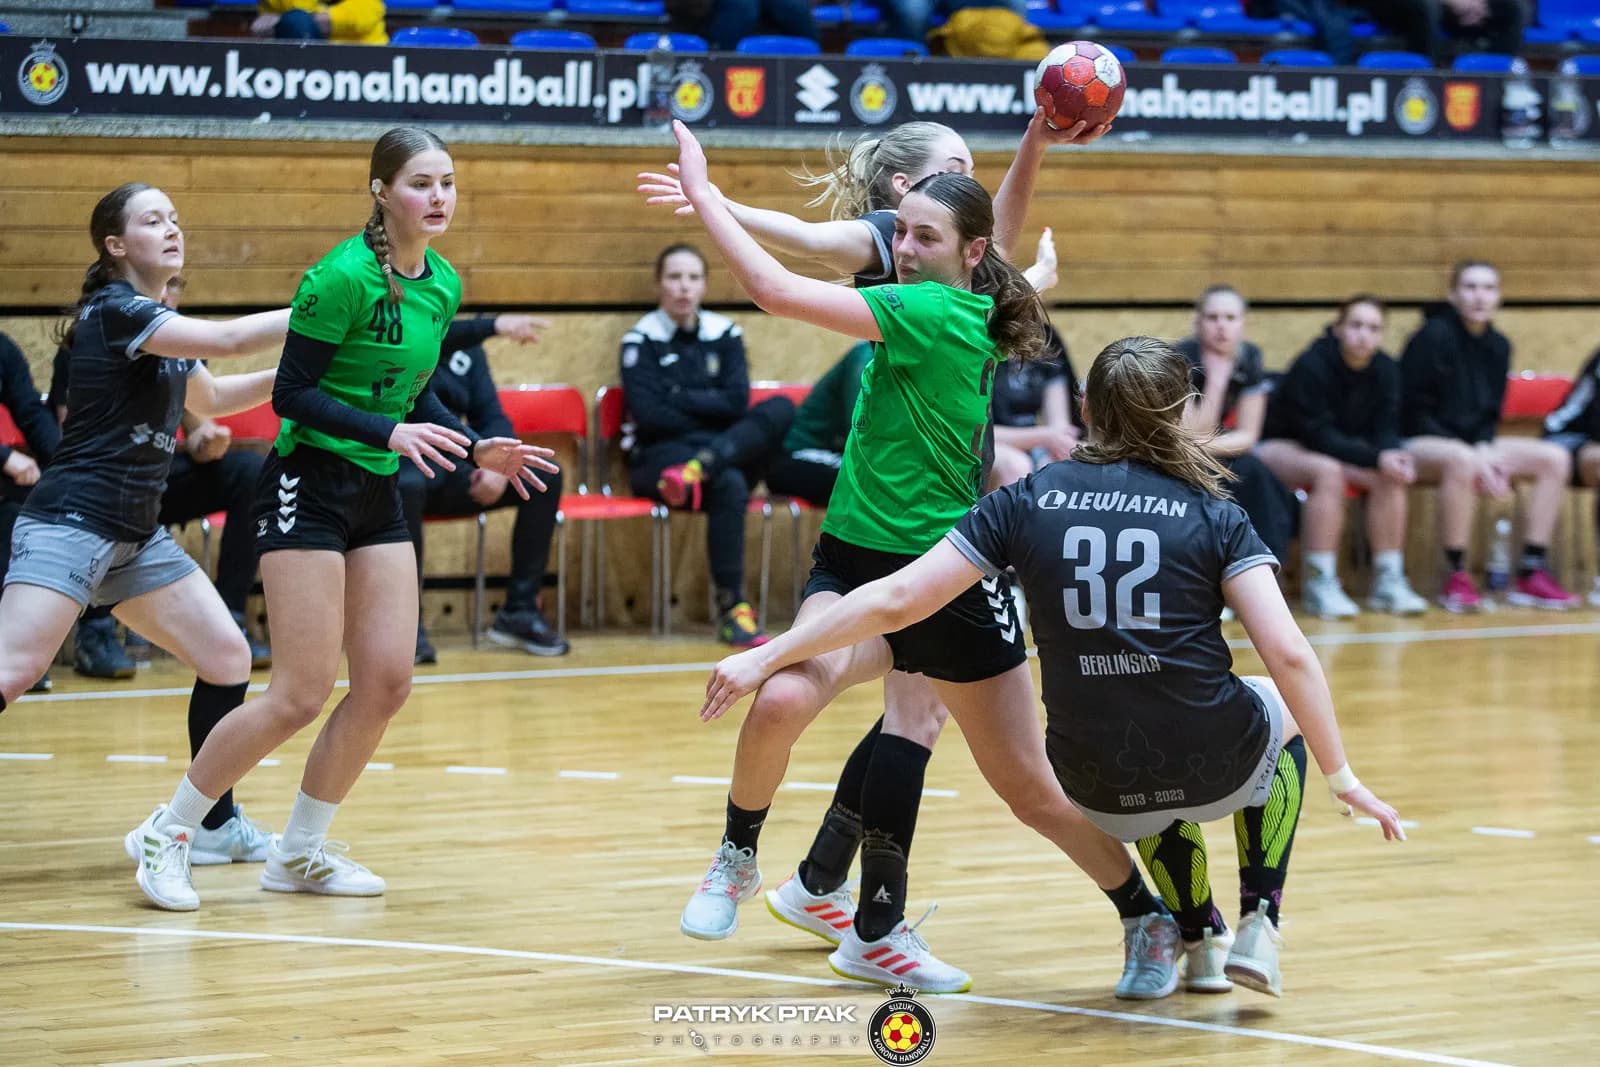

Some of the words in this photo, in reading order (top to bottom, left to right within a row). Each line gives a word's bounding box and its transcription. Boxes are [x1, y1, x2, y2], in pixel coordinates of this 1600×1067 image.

[85, 49, 652, 123] www.koronahandball.pl
[367, 298, 403, 346] 48
[1067, 491, 1188, 517] LEWIATAN
[1063, 525, 1160, 630] 32
[1079, 649, 1161, 676] BERLIŃSKA
[1119, 793, 1146, 807] 2013
[1154, 789, 1185, 803] 2023
